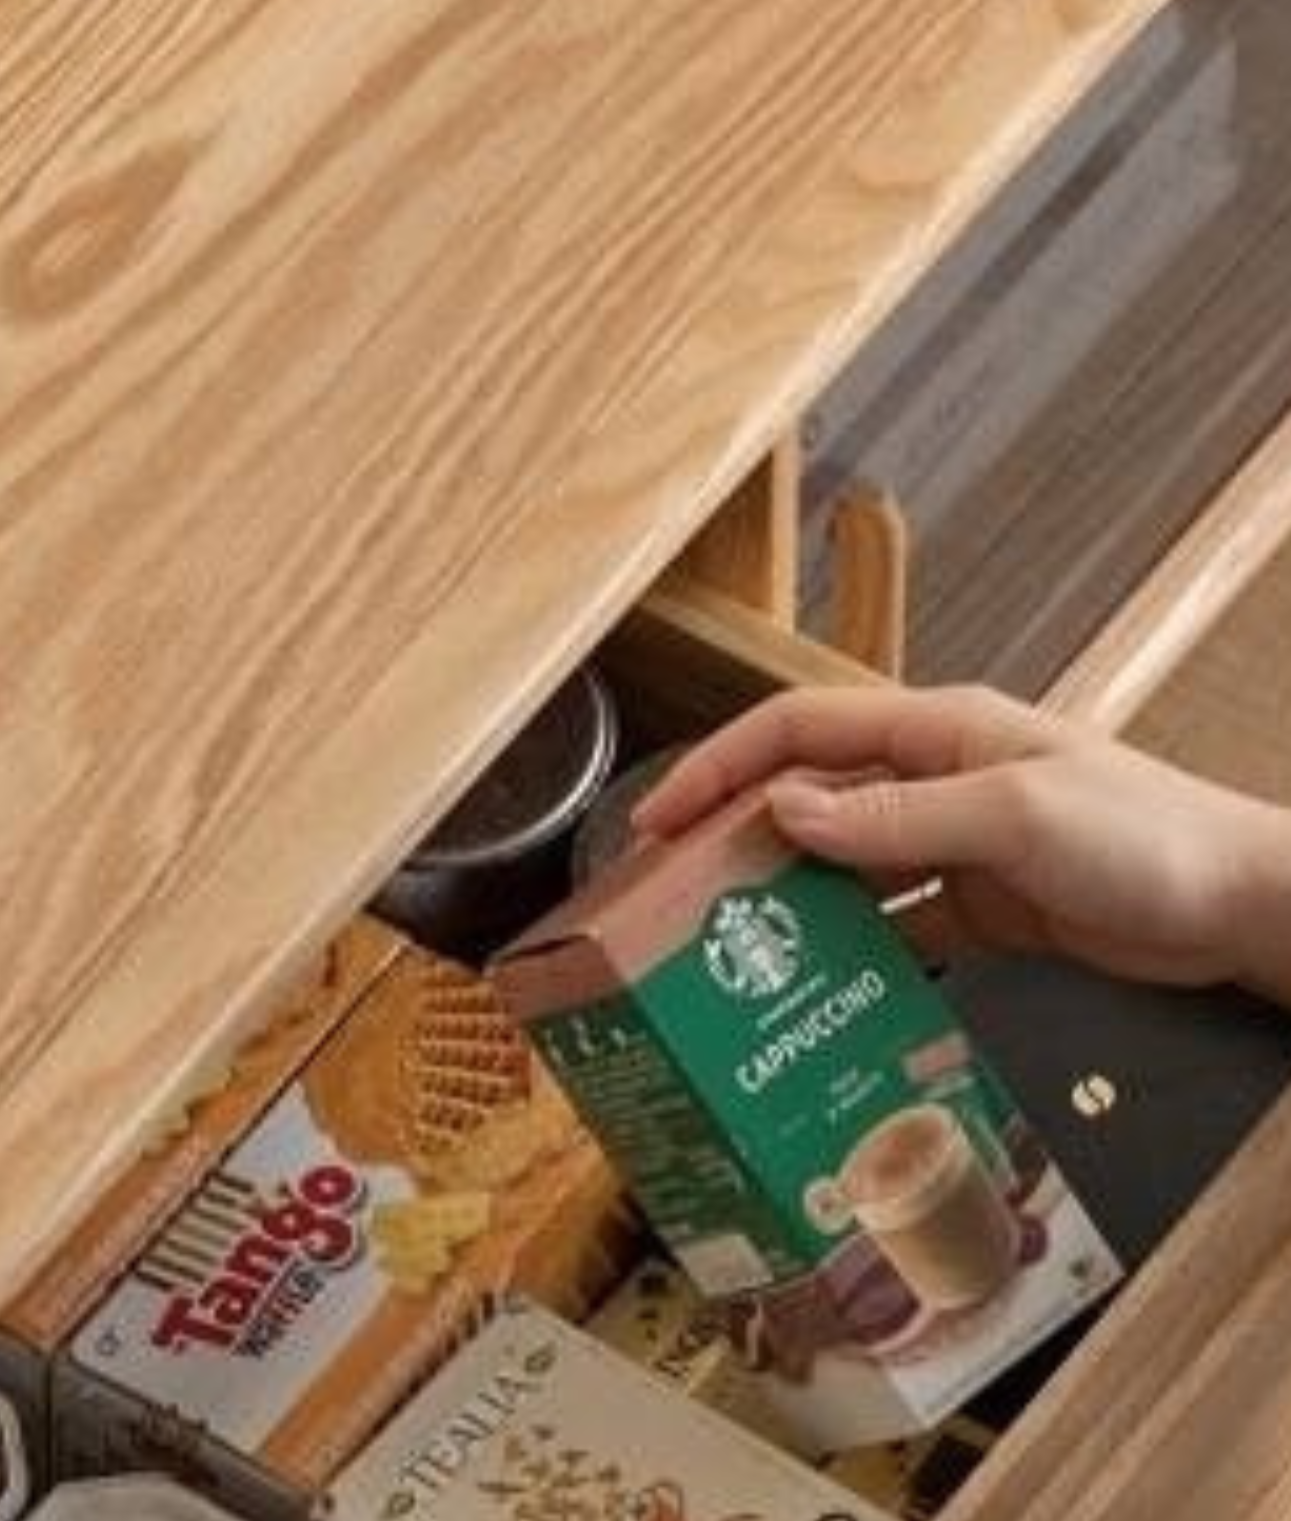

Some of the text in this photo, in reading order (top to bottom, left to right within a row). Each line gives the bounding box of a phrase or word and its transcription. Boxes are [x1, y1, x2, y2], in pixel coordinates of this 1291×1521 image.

[734, 969, 886, 1094] CAPPUCCINO
[152, 1165, 356, 1356] Tango
[400, 1376, 543, 1491] TEALIA
